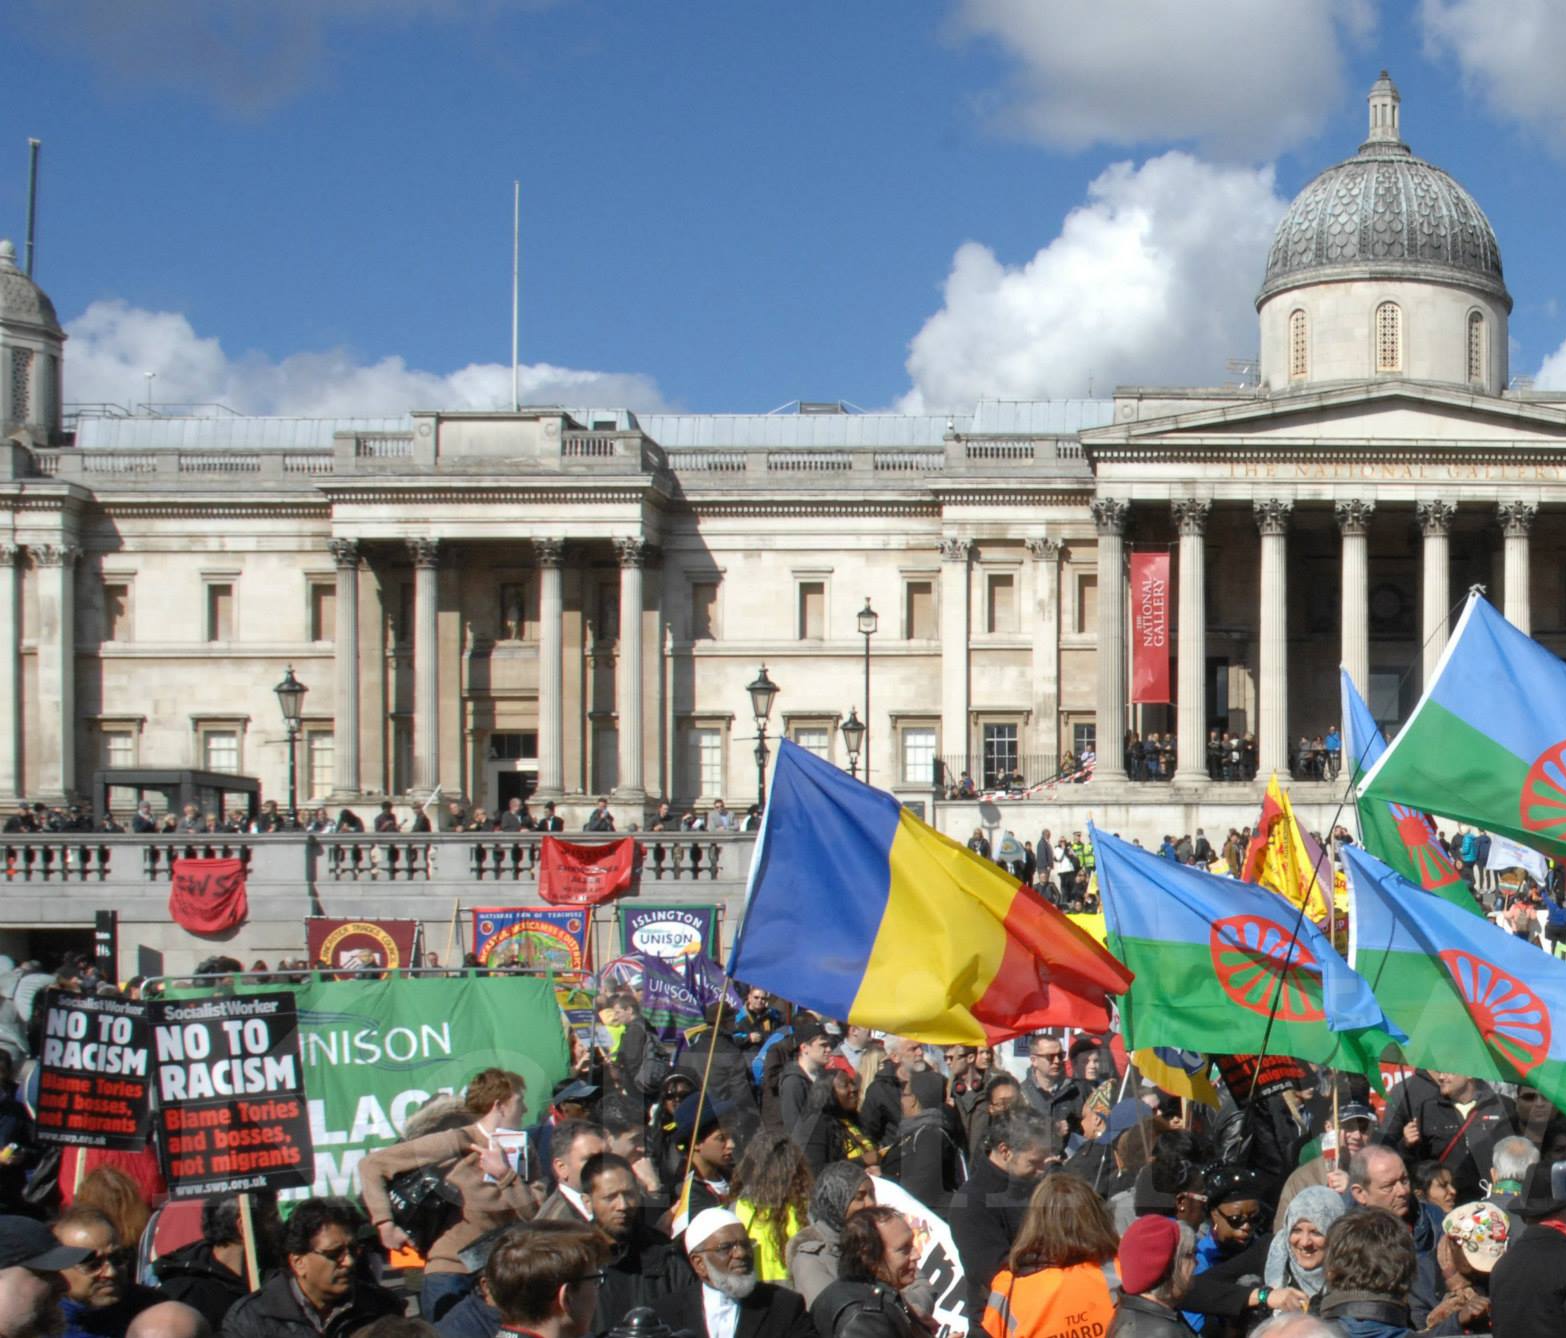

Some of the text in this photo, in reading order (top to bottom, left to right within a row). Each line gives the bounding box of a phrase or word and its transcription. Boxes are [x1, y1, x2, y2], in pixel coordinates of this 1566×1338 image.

[1227, 463, 1564, 479] THE NATIONAL GALLERY
[1142, 576, 1153, 647] NATIONAL
[1153, 577, 1164, 647] GALLERY
[632, 910, 704, 928] ISLINGTON
[639, 933, 693, 945] UNISON
[46, 1008, 133, 1045] NO TO
[155, 1018, 270, 1062] NO TO
[44, 1037, 148, 1076] RACISM
[300, 1021, 452, 1067] NISON
[41, 1073, 144, 1098] Blame Tories
[160, 1055, 296, 1101] RACISM
[40, 1093, 133, 1117] and bosses,
[165, 1100, 299, 1131] Blame Tories
[39, 1112, 137, 1134] not migrants
[168, 1126, 292, 1154] and bosses,
[171, 1156, 205, 1177] not
[211, 1145, 301, 1173] migrants
[176, 1177, 267, 1196] www.swp.org.uk
[1064, 1311, 1088, 1326] TUC
